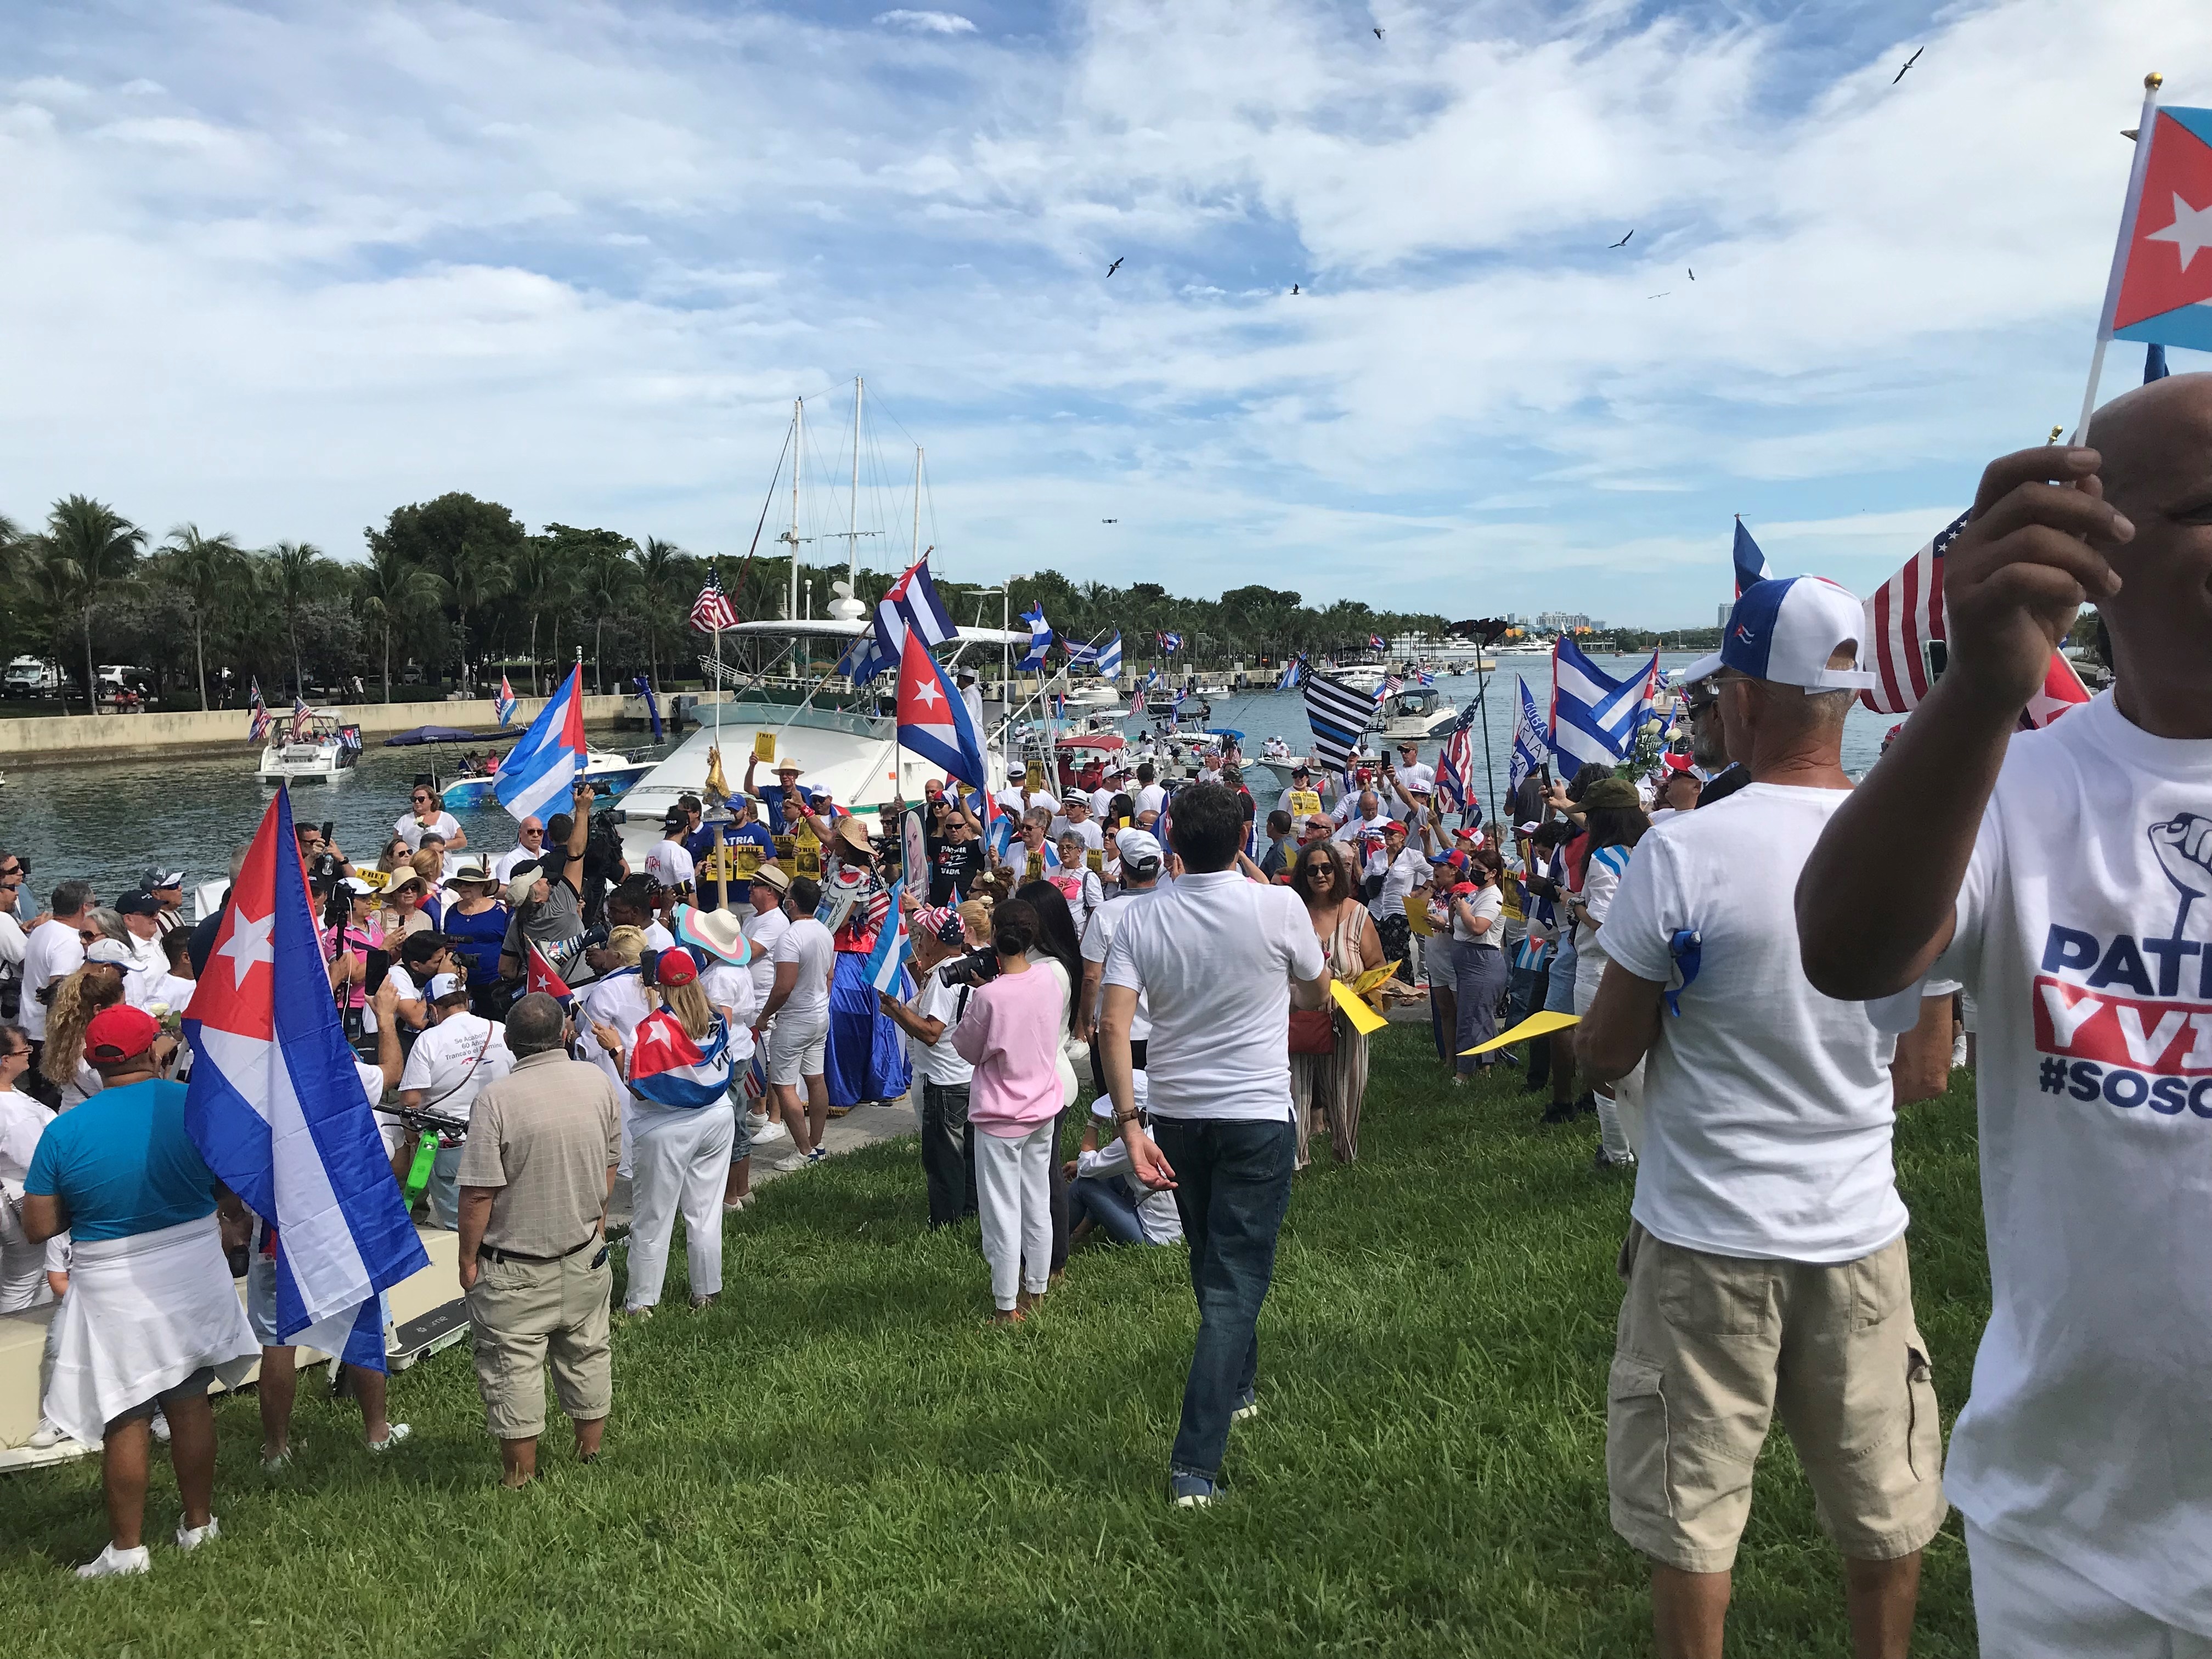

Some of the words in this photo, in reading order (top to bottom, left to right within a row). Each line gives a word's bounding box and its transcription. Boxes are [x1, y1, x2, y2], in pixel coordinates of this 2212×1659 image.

[1525, 702, 1547, 737] CUBA
[723, 836, 755, 845] ATRIA
[362, 870, 386, 881] FREE
[1507, 871, 1519, 881] FRE
[464, 1031, 488, 1043] Acabo!!!
[445, 1050, 471, 1060] Tranca'o
